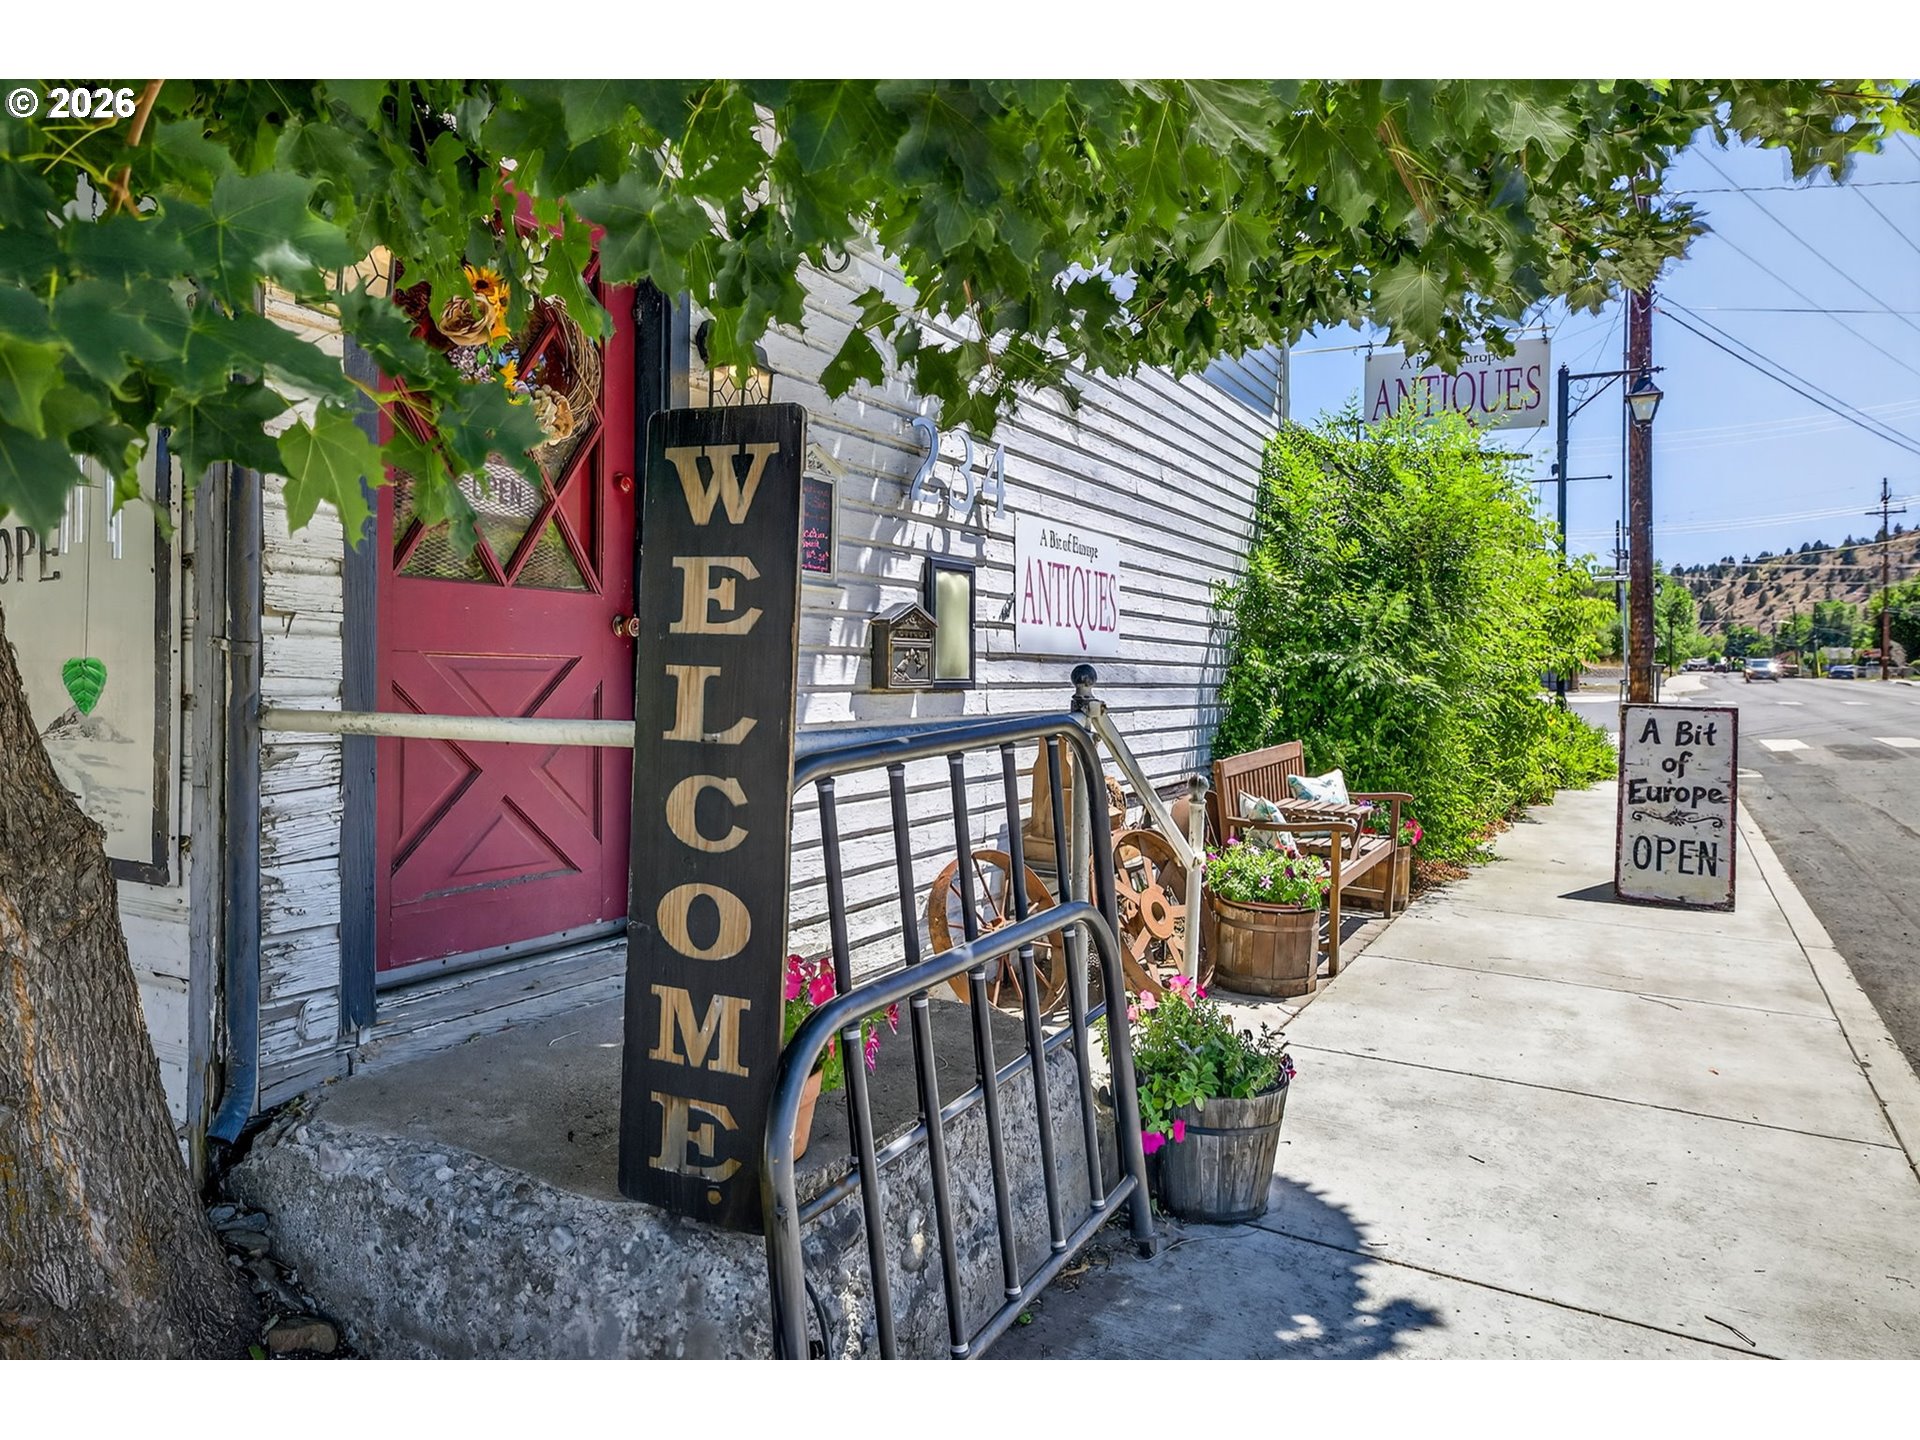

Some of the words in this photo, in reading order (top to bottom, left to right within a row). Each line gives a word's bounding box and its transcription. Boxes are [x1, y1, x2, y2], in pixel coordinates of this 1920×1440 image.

[1400, 357, 1411, 370] A
[1461, 353, 1503, 366] urope
[1372, 364, 1541, 428] ANTIQUES
[909, 416, 1006, 520] 234
[1040, 528, 1048, 547] A
[1049, 529, 1062, 550] Bit
[1062, 533, 1072, 552] of
[1072, 536, 1099, 563] Europe
[1021, 555, 1117, 651] ANTIQUES
[1639, 718, 1661, 745] A
[1675, 720, 1717, 746] Bit
[1661, 751, 1693, 779] of
[1628, 778, 1730, 809] Europe
[649, 443, 780, 1183] WELCOME
[1632, 836, 1718, 877] OPEN
